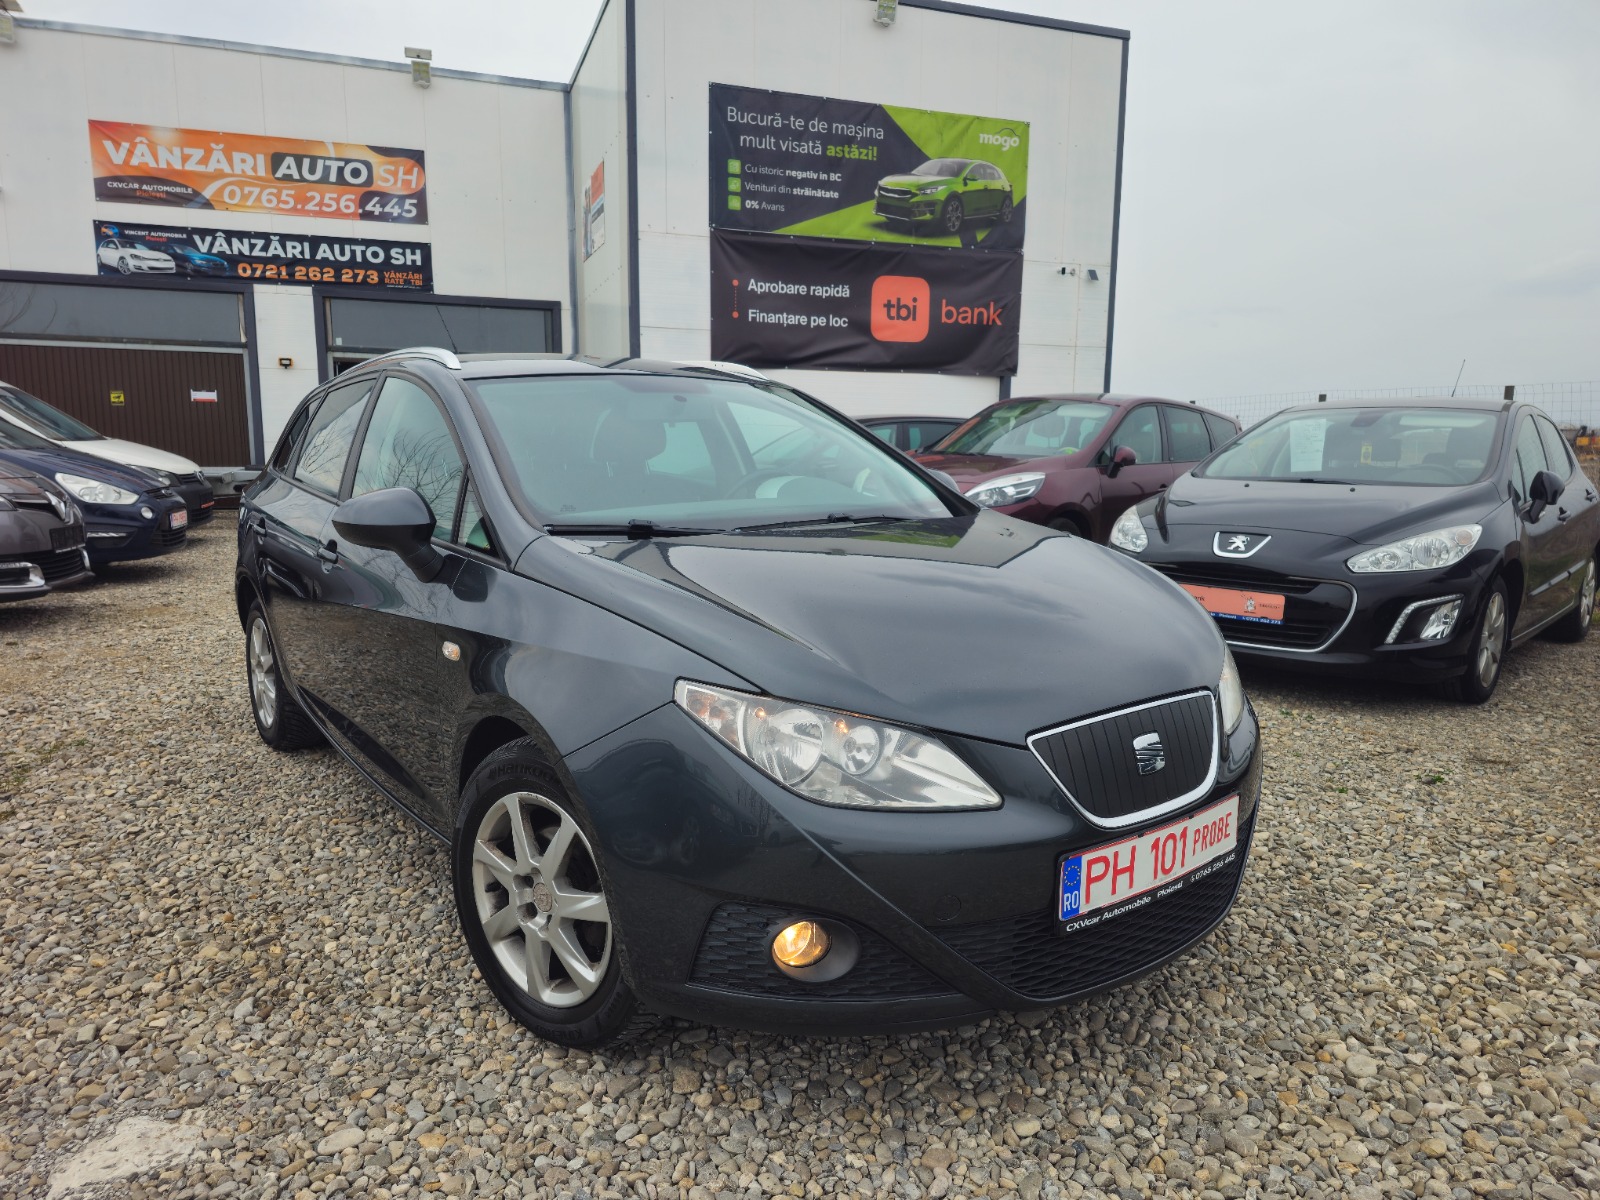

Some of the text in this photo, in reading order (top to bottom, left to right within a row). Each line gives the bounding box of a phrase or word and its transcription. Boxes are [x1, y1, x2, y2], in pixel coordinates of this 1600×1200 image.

[727, 106, 884, 141] Bucură-te de mașina
[740, 135, 878, 161] mult visată astăzi!
[979, 133, 1020, 152] mogo
[102, 136, 419, 189] VÂNZĂRI AUTO SH
[745, 164, 757, 173] Cu
[759, 165, 784, 176] istoric
[786, 169, 818, 180] negativ
[829, 173, 843, 182] BC
[107, 181, 193, 194] CXVCAR AUTOMOBILE
[745, 182, 840, 198] Venituri din străinătate
[223, 185, 418, 218] 0765.256.445
[745, 200, 785, 212] 0% Avans
[150, 231, 187, 239] AUTOMOBILE
[192, 232, 422, 266] VÂNZĂRI AUTO SH
[237, 262, 379, 284] 0721 262 273
[747, 278, 850, 299] Aprobare rapidă
[748, 309, 849, 328] Finanțare pe loc
[883, 297, 1002, 325] tbi bank
[1085, 812, 1232, 905] PH 101 PROBE
[1063, 890, 1079, 912] RO
[1066, 916, 1101, 932] CXVcar
[1102, 896, 1151, 921] Automobile
